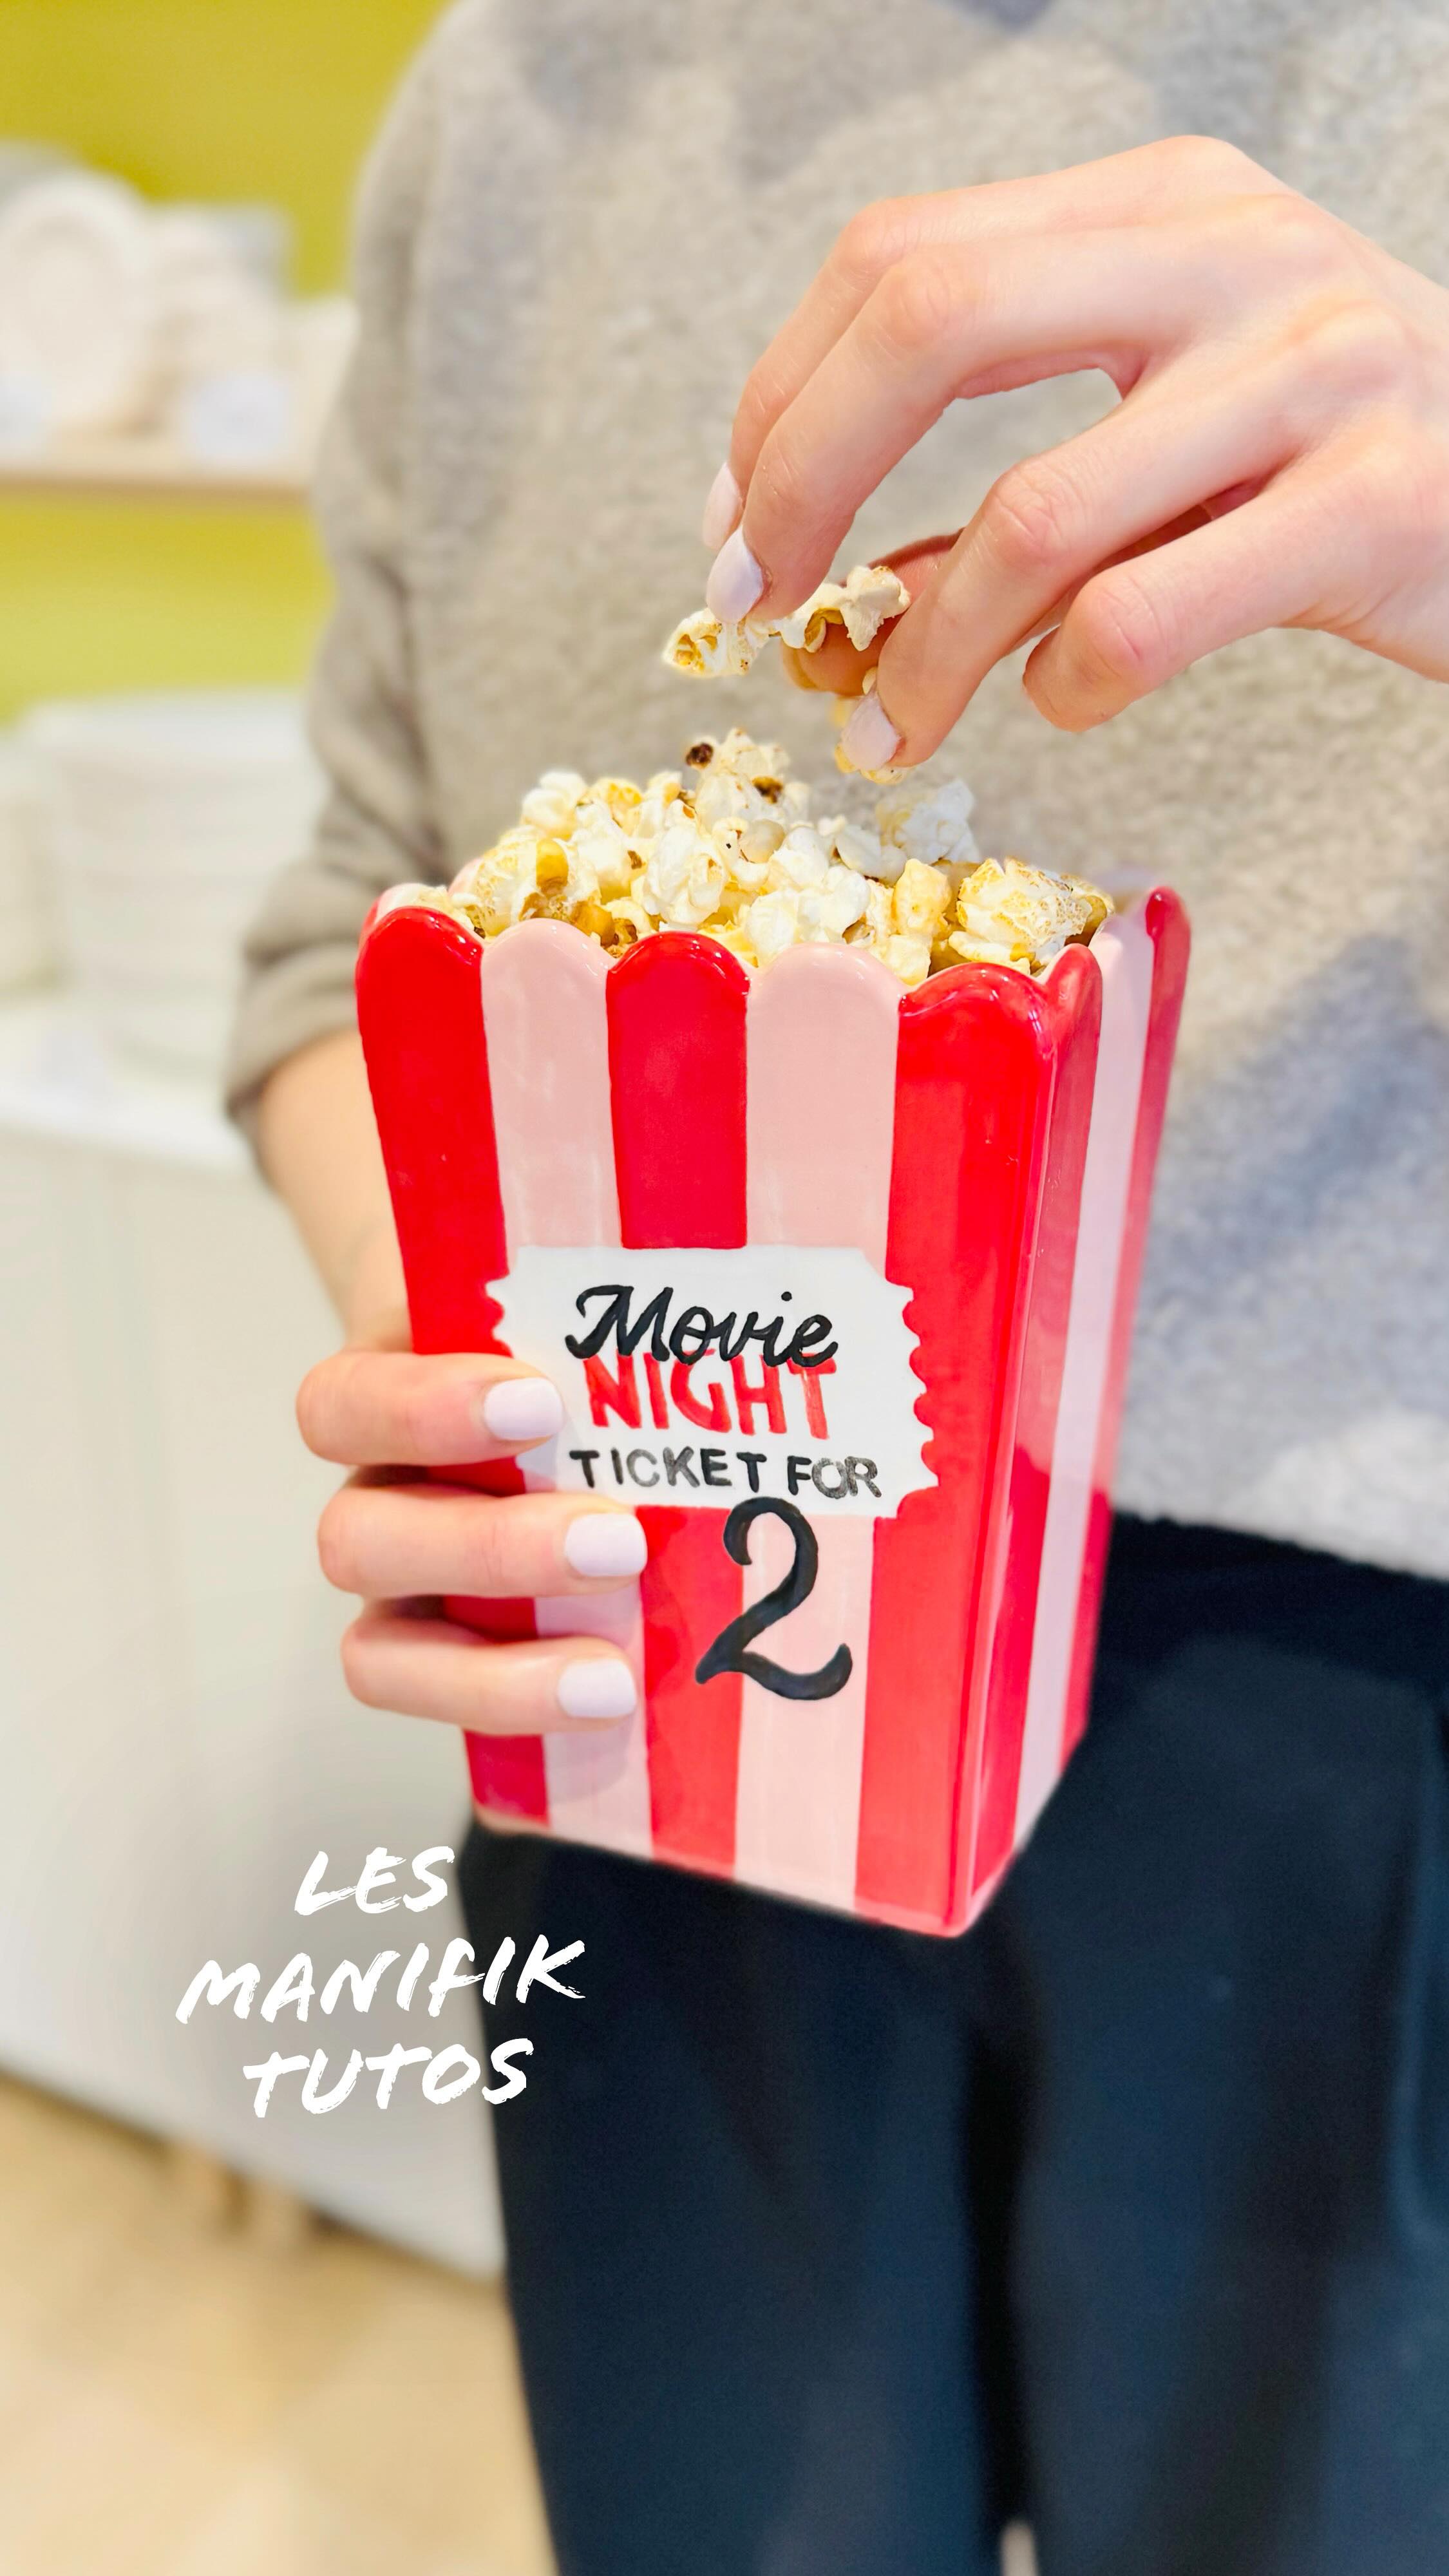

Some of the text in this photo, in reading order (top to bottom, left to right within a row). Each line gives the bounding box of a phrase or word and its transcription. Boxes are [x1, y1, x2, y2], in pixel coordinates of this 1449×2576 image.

[565, 1285, 838, 1367] Movie
[582, 1349, 837, 1439] NIGHT
[569, 1446, 882, 1498] TICKET FOR
[695, 1497, 853, 1700] 2
